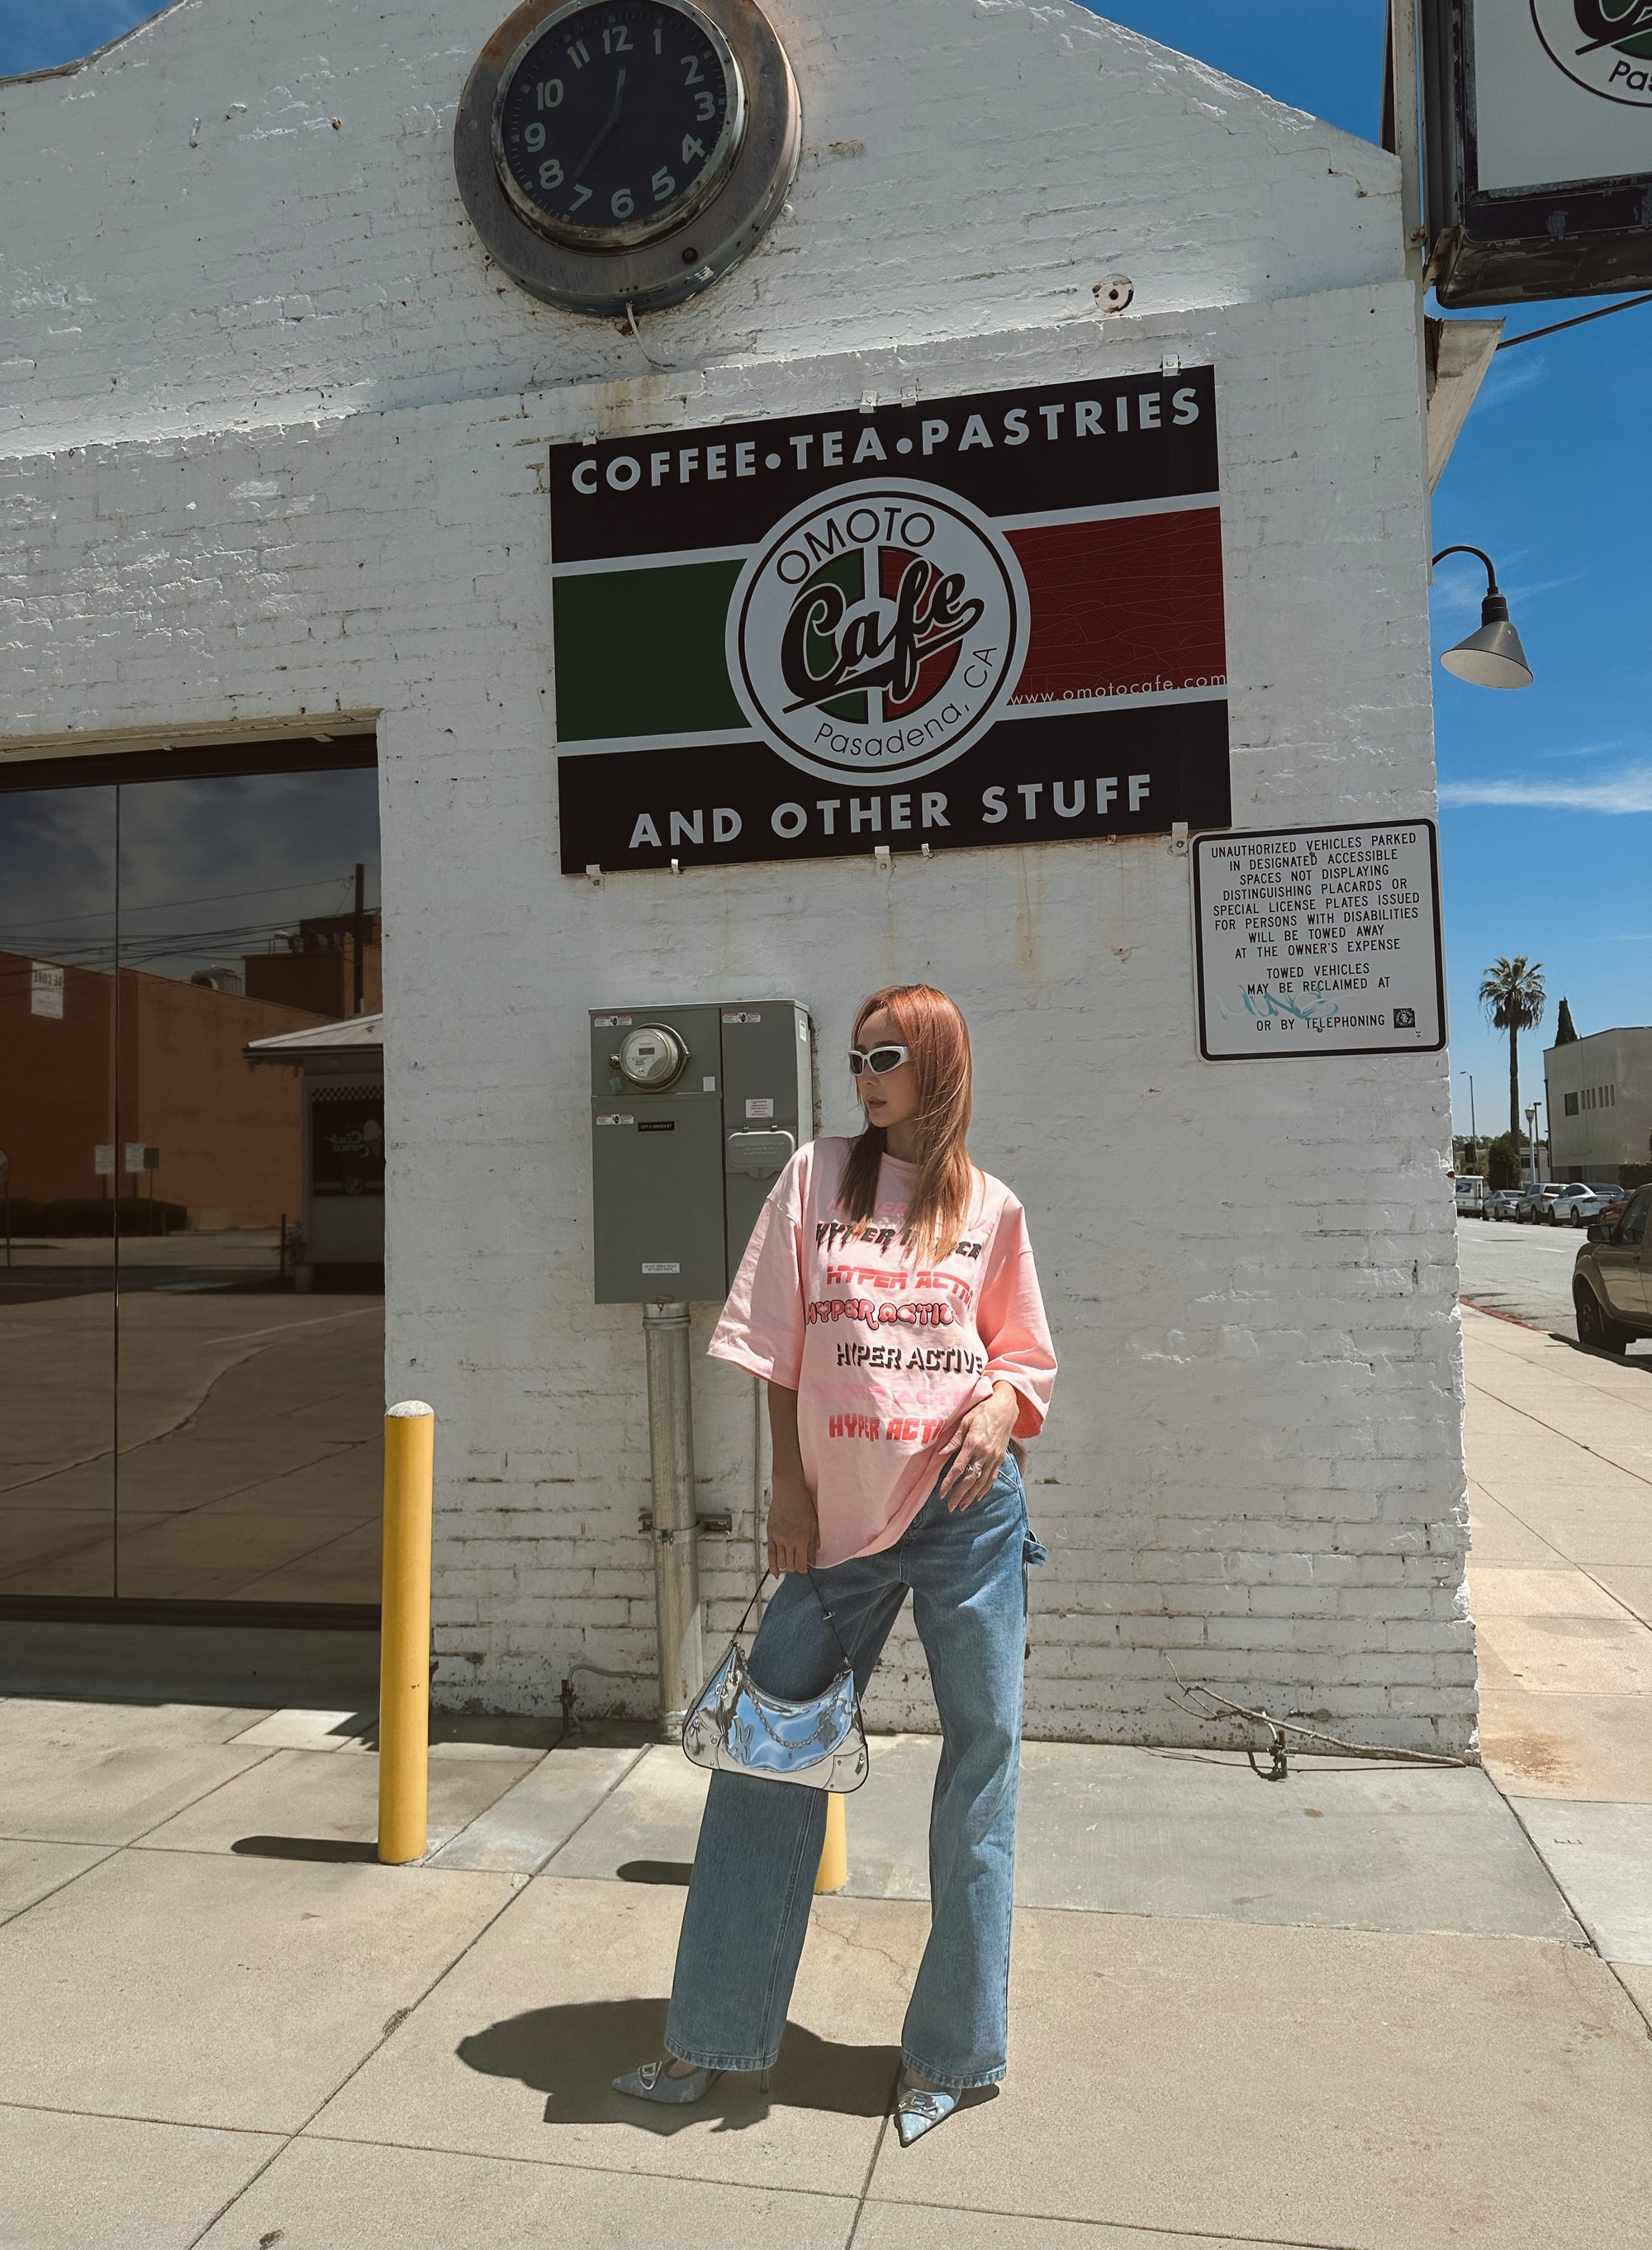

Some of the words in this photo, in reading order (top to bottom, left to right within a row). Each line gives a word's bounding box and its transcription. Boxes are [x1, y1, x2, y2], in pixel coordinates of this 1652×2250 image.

[567, 40, 591, 69] 11
[602, 26, 634, 54] 12
[653, 28, 662, 55] 1
[681, 55, 704, 86] 2
[537, 78, 564, 111] 10
[694, 91, 715, 121] 3
[525, 122, 546, 153] 9
[681, 133, 706, 164] 4
[539, 159, 564, 190] 8
[651, 166, 676, 202] 5
[568, 183, 593, 212] 7
[610, 188, 634, 218] 6
[776, 506, 935, 585] OMOTO
[781, 558, 985, 714] Cafe
[814, 703, 970, 757] Pasadena,
[964, 647, 998, 688] CA
[1009, 674, 1226, 706] www.omotocafe.com
[628, 807, 743, 848] AND
[771, 791, 952, 838] OTHER
[981, 773, 1151, 824] STUFF
[1211, 841, 1297, 858] UNAUTHORIZED
[1306, 836, 1362, 852] VEHICLES
[1371, 832, 1417, 847] PARKED
[1229, 860, 1241, 872] IN
[1249, 854, 1317, 871] DESIGNATED
[1327, 848, 1398, 865] ACCESSIBLE
[1239, 871, 1282, 885] SPACES
[1290, 869, 1312, 882] NOT
[1322, 864, 1389, 880] DISPLAYING
[1222, 884, 1312, 901] DISTINGUISHING
[1321, 879, 1382, 895] PLACARDS
[1392, 877, 1408, 890] OR
[1213, 903, 1260, 917] SPECIAL
[1269, 899, 1317, 913] LICENSE
[1325, 895, 1369, 909] PLATES
[1378, 892, 1420, 905] ISSUED
[1214, 919, 1236, 931] FOR
[1245, 914, 1297, 929] PERSONS
[1307, 912, 1335, 925] WITH
[1343, 907, 1419, 923] DISABILITIES
[1248, 931, 1273, 944] WILL
[1284, 929, 1298, 942] BE
[1308, 927, 1346, 940] TOWED
[1356, 923, 1384, 938] AWAY
[1235, 947, 1247, 959] AT
[1256, 946, 1279, 958] THE
[1288, 942, 1338, 956] OWNER'S
[1347, 938, 1401, 952] EXPENSE
[1247, 983, 1270, 995] MAY
[1279, 981, 1294, 994] BE
[1303, 978, 1368, 992] RECLAIMED
[1378, 976, 1391, 989] AT
[1266, 966, 1304, 980] TOWED
[1313, 962, 1370, 976] VEHICLES
[1256, 1019, 1271, 1032] OR
[1280, 1018, 1295, 1031] BY
[1305, 1013, 1386, 1031] TELEPHONING
[826, 1265, 909, 1290] HYPER
[806, 1298, 879, 1330] HYPER
[836, 1342, 903, 1370] HYPER
[828, 1412, 881, 1442] HYPER
